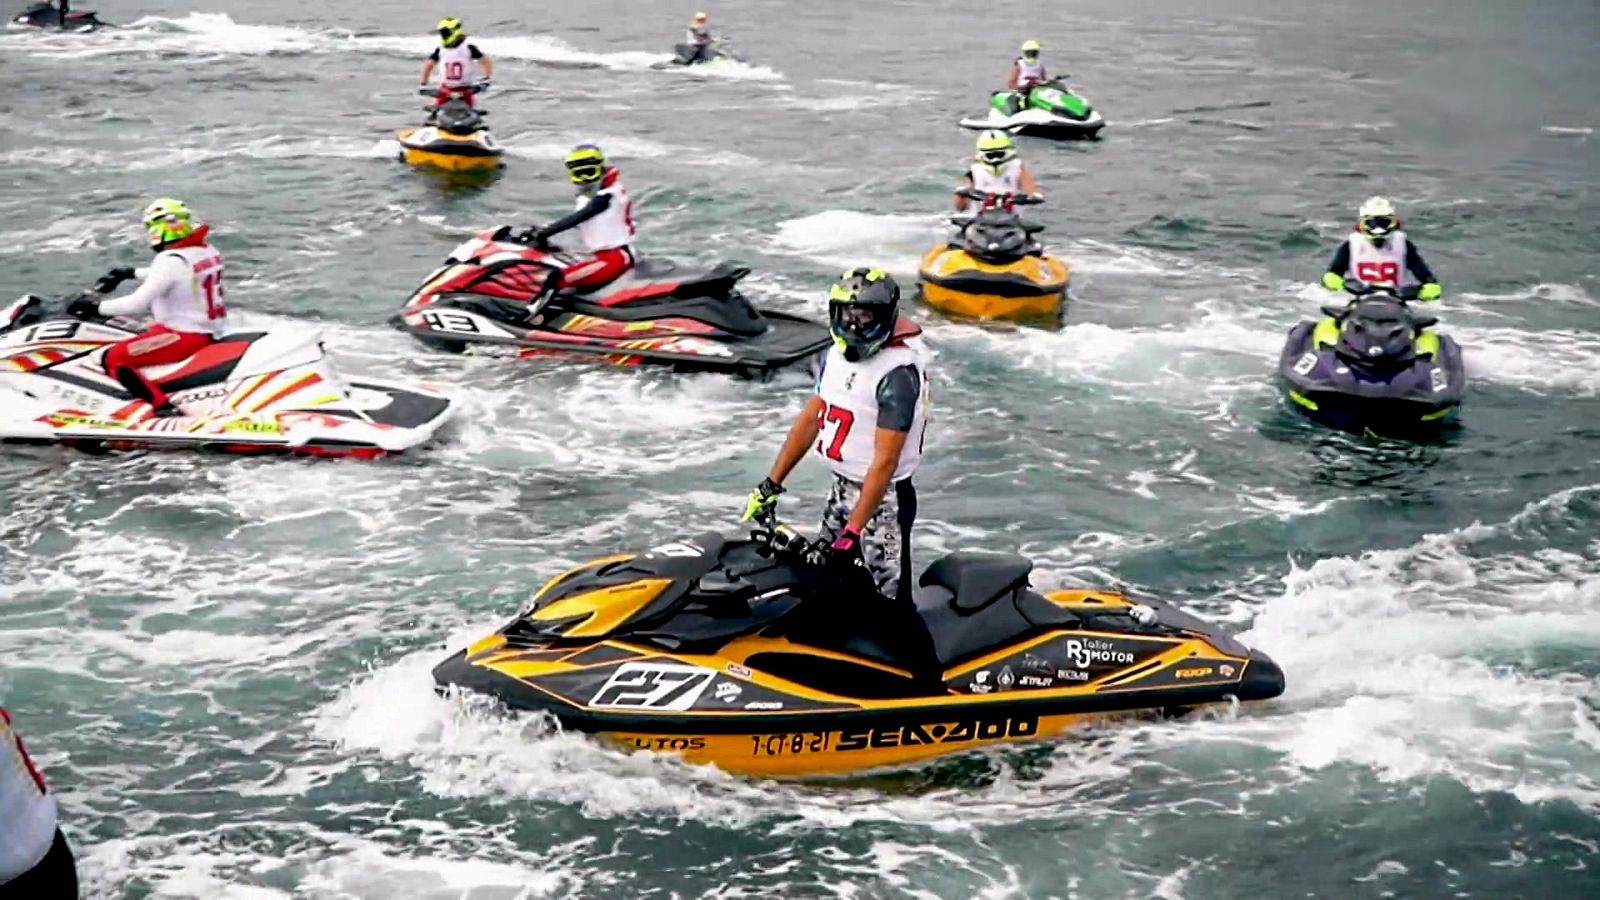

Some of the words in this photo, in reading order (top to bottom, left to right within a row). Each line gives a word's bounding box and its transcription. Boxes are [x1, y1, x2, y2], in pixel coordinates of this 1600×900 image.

[444, 61, 463, 80] 10
[26, 322, 80, 342] 13
[422, 312, 480, 333] 43
[1091, 650, 1134, 664] MOTOR
[594, 670, 710, 706] 27
